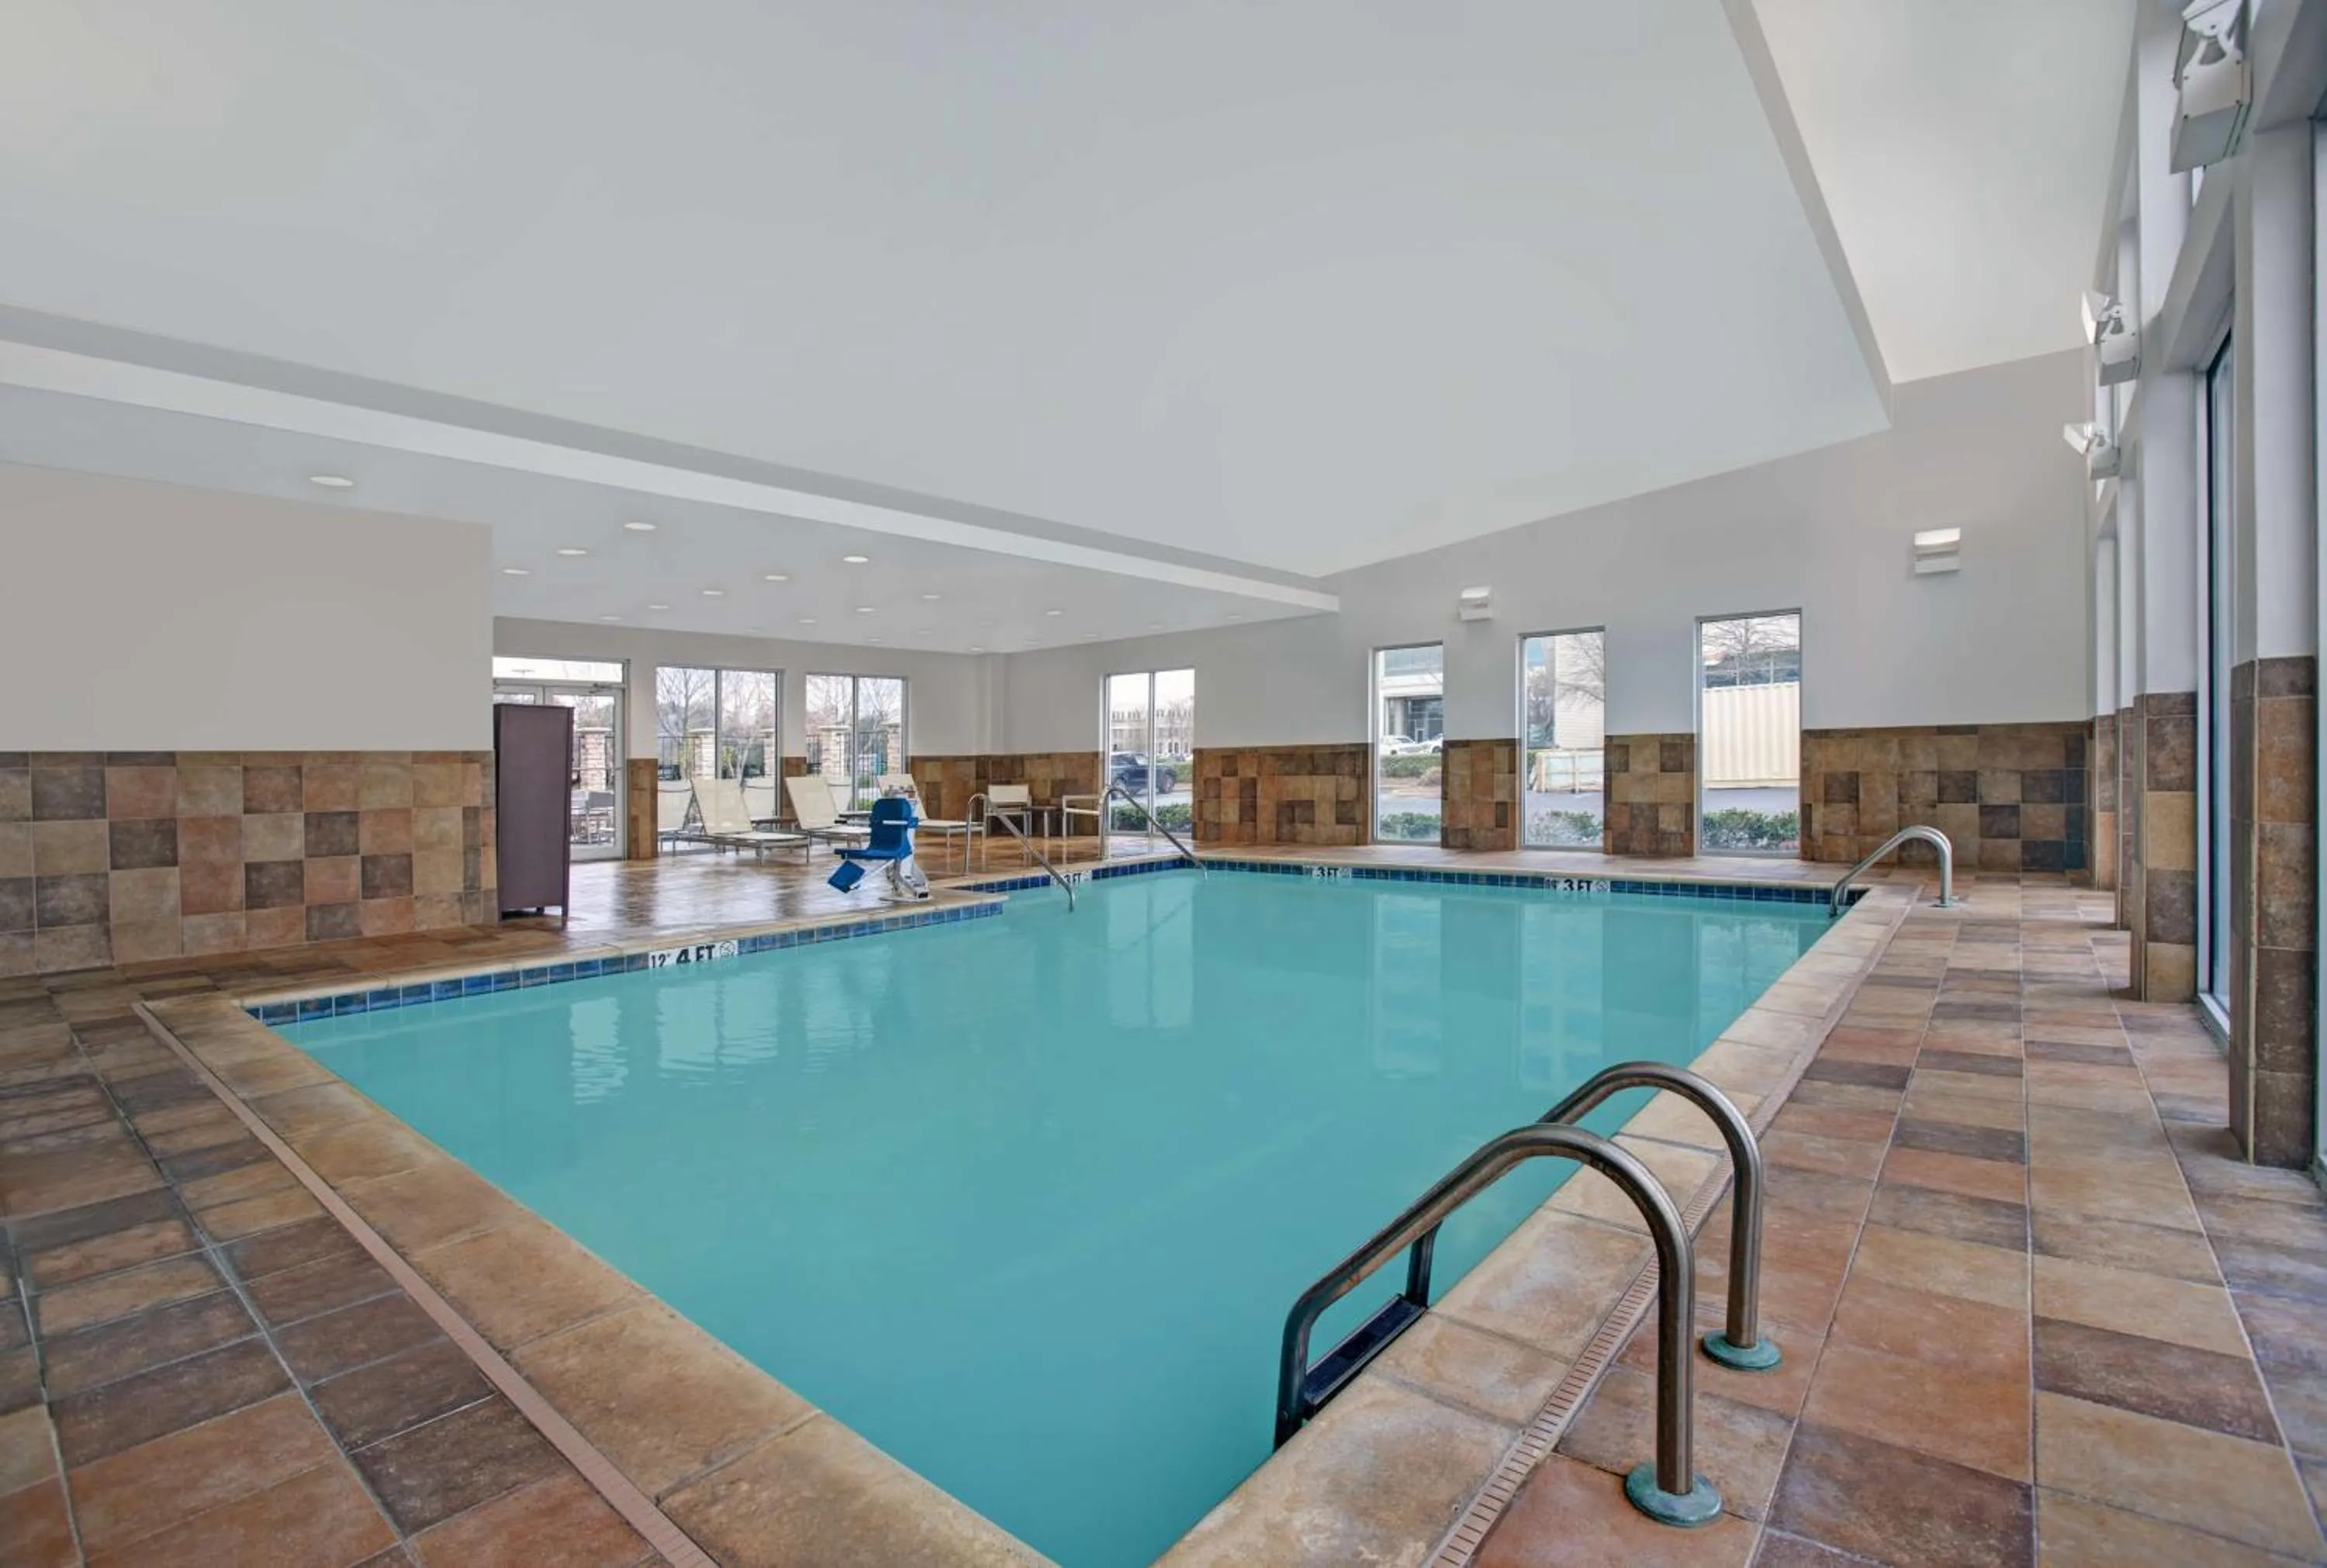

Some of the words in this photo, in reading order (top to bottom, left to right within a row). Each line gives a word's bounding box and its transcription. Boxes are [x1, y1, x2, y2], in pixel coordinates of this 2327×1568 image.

[1316, 866, 1326, 877] 3
[1327, 868, 1339, 878] FT
[1563, 879, 1575, 891] 3
[1577, 879, 1592, 892] FT
[676, 948, 691, 964] 4
[696, 945, 715, 962] FT
